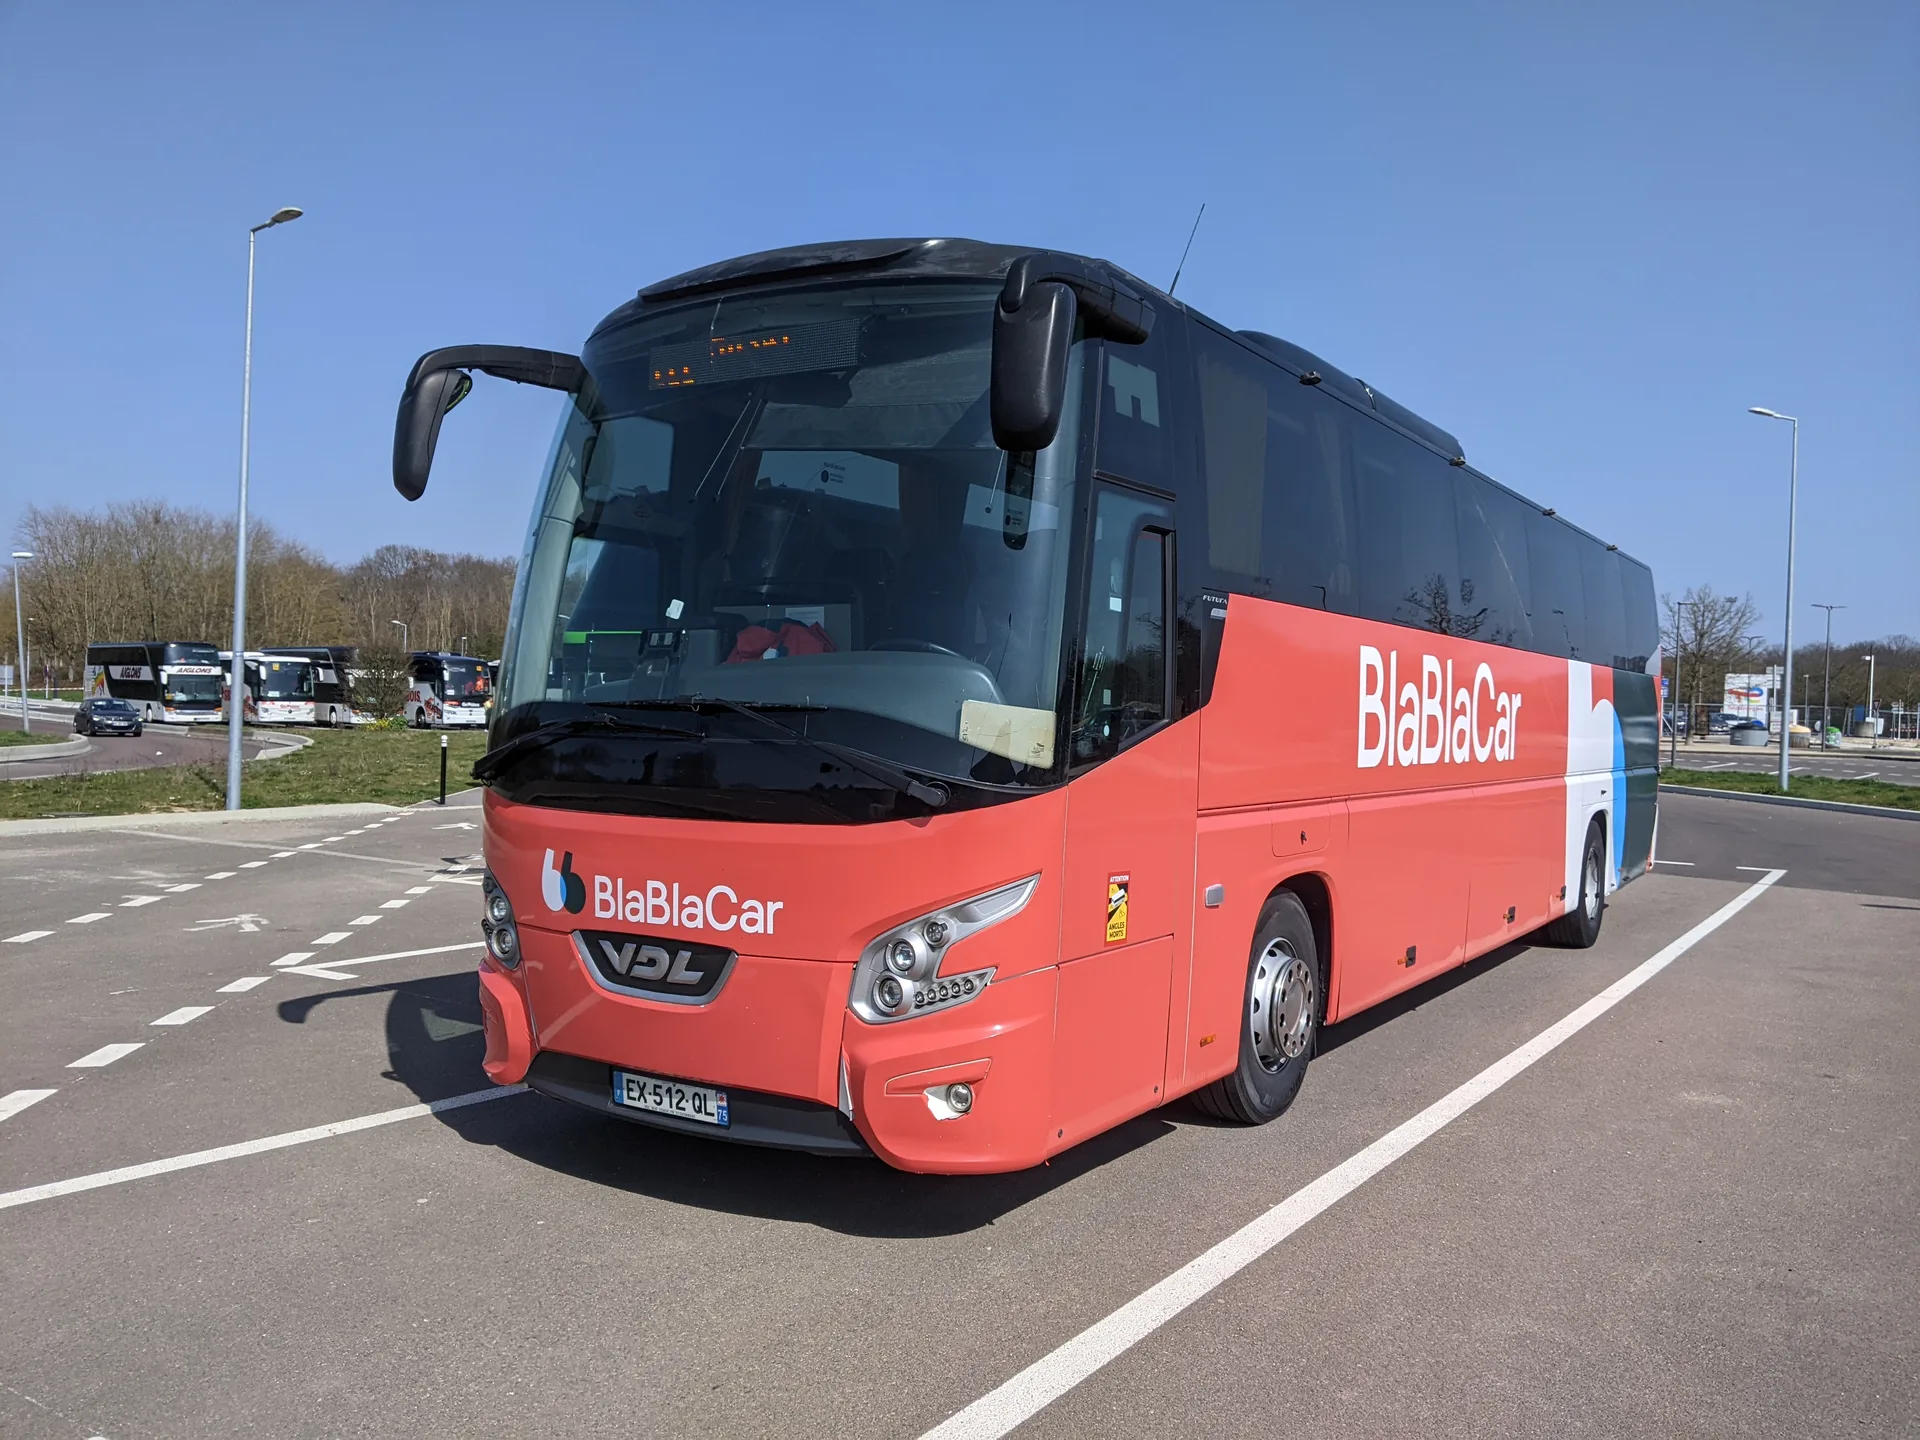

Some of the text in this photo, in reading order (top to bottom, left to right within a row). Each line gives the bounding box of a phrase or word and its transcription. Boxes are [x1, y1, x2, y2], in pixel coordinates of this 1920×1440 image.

[1203, 595, 1228, 605] FUTURA
[120, 666, 142, 679] AIGLONS
[1357, 645, 1522, 769] BlaBlaCar
[594, 875, 784, 934] BlaBlaCar
[1109, 921, 1125, 931] ANGLES
[1109, 929, 1124, 939] MORTS
[598, 939, 704, 985] VDL
[717, 1109, 728, 1122] 75
